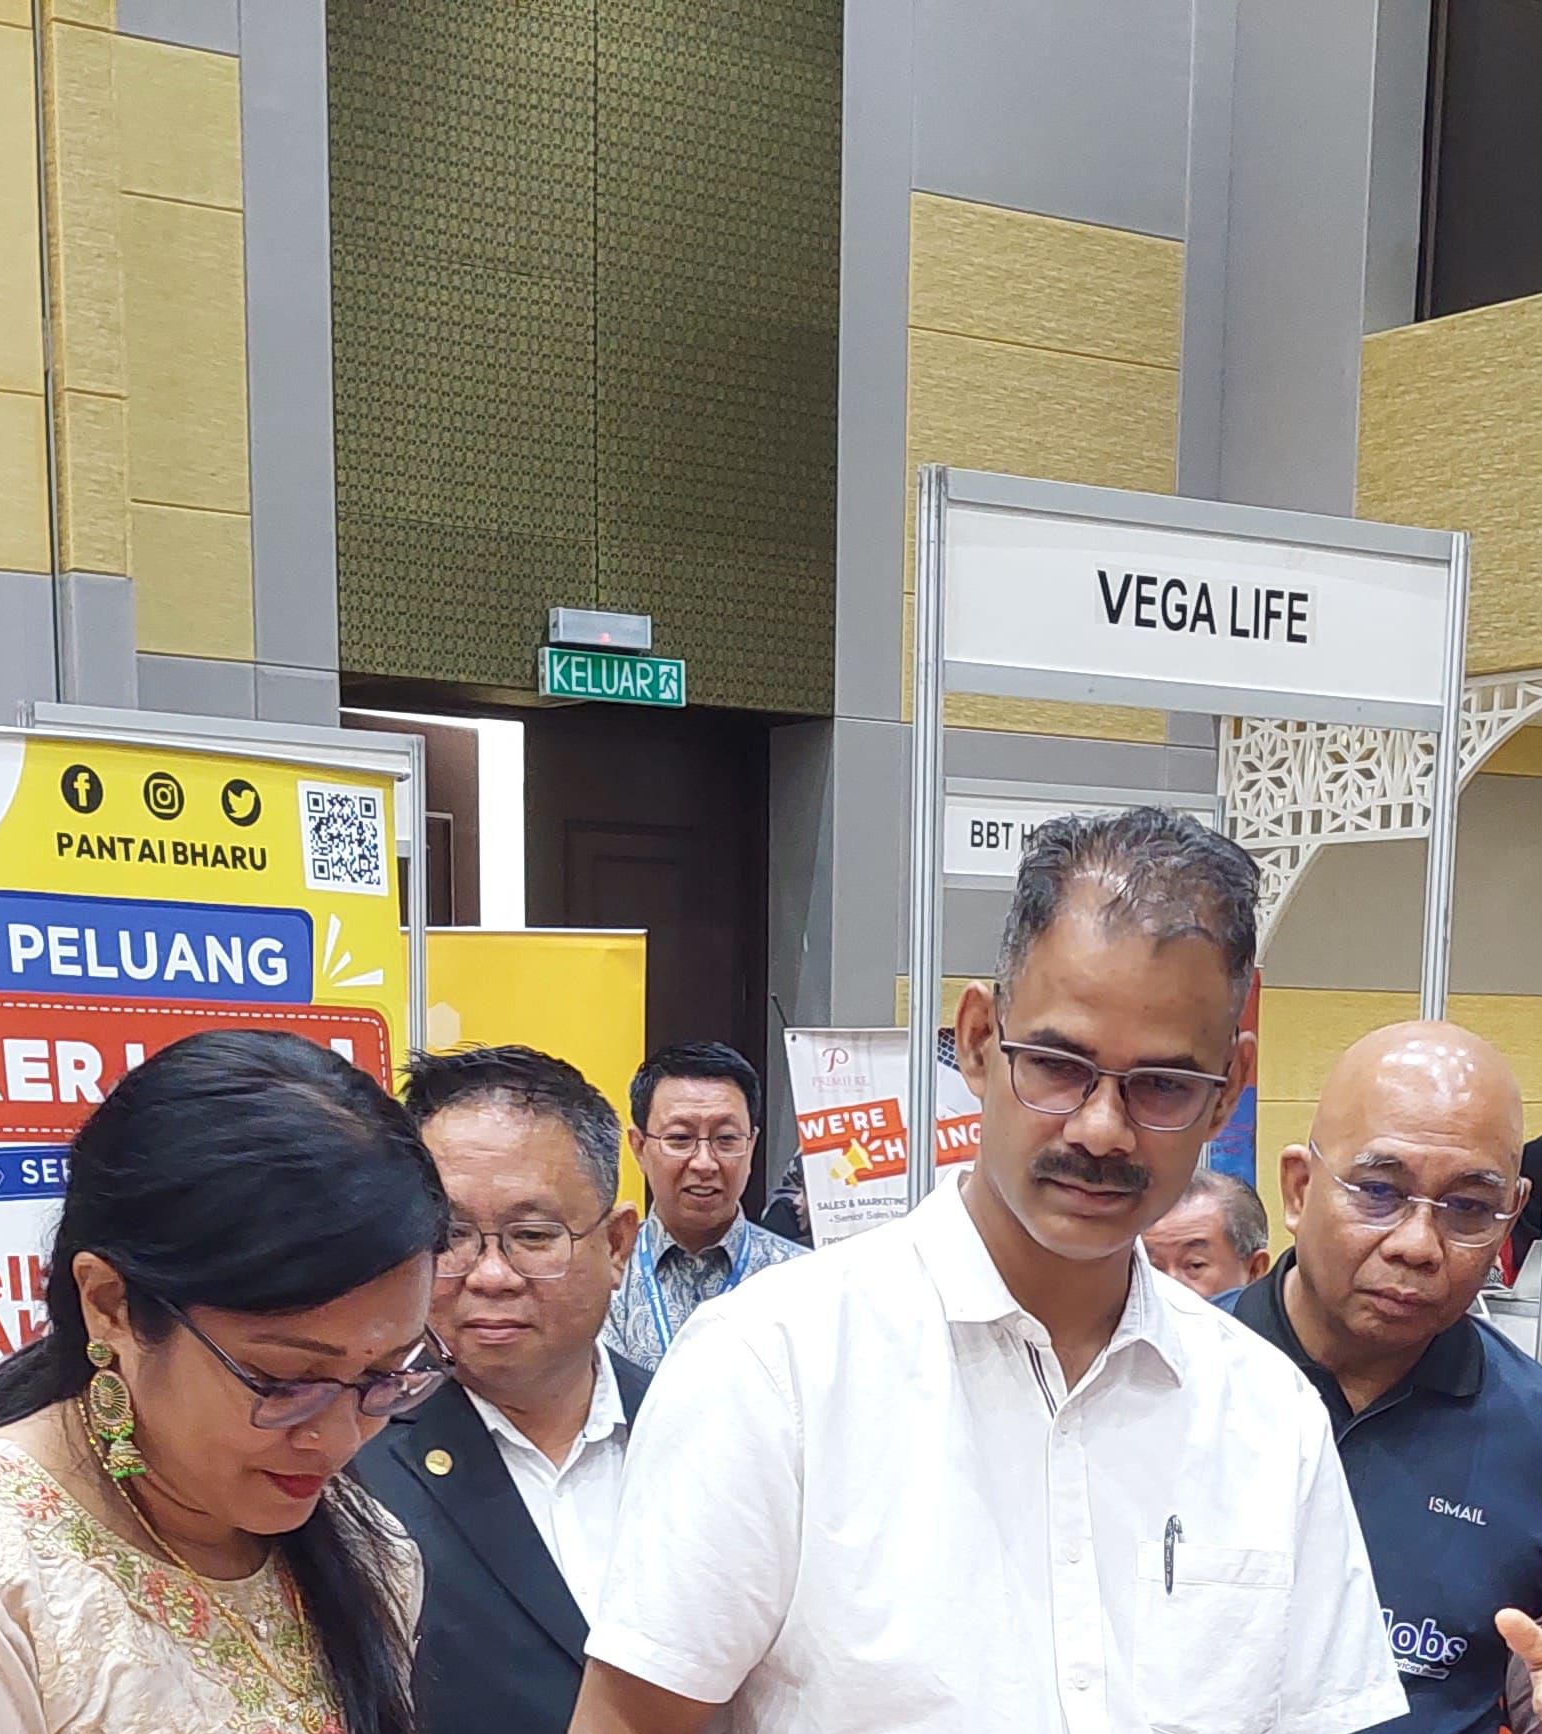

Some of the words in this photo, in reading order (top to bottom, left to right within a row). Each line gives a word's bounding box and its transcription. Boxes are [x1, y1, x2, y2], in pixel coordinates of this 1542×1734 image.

[1096, 569, 1217, 635] VEGA
[1230, 586, 1309, 644] LIFE
[551, 652, 654, 699] KELUAR
[970, 819, 1015, 851] BBT
[7, 923, 289, 987] PELUANG
[798, 1106, 888, 1141] WE'RE
[816, 1199, 847, 1211] SALES
[1428, 1495, 1488, 1527] ISMAIL
